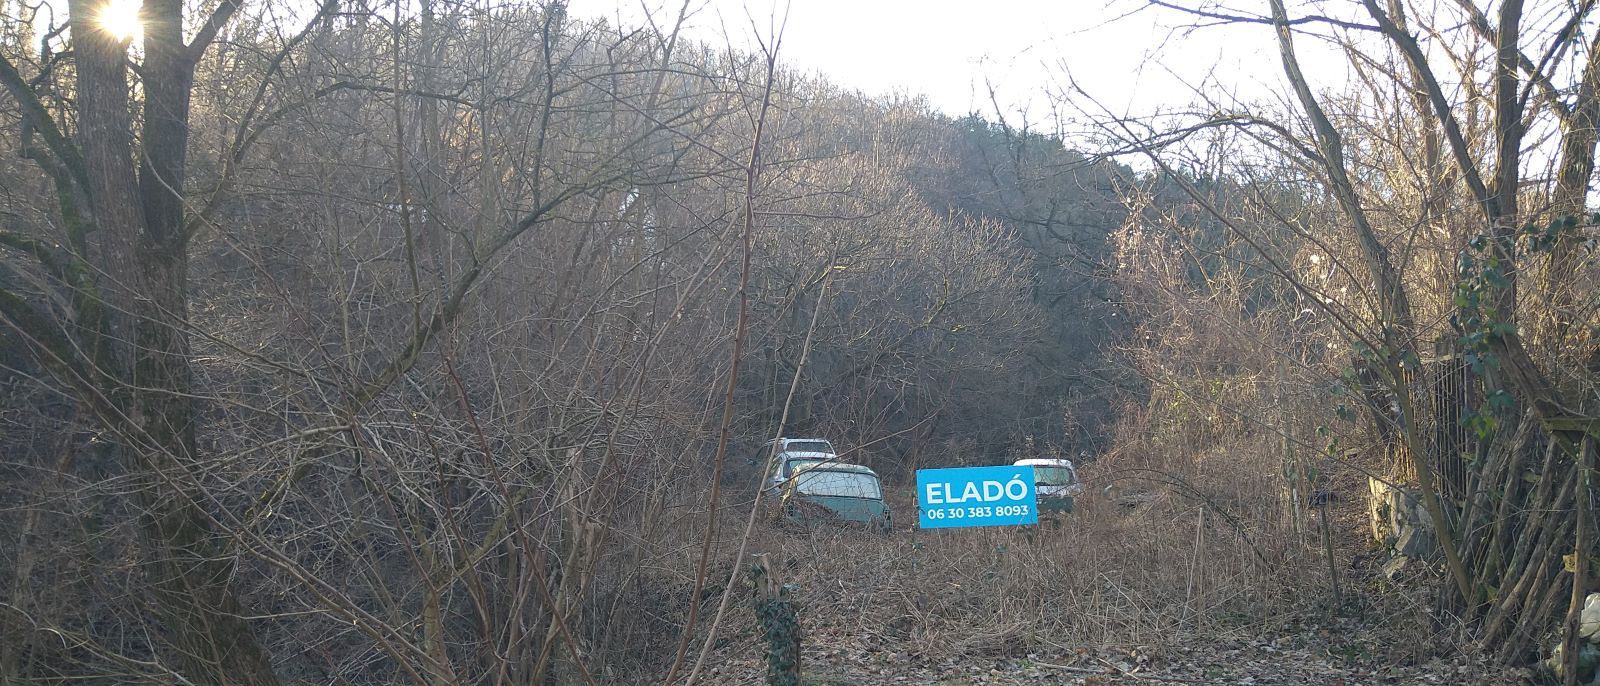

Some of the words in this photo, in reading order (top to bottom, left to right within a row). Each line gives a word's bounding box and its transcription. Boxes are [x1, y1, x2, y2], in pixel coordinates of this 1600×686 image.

[926, 473, 1028, 504] ELADÓ
[927, 509, 945, 520] 06
[947, 508, 965, 519] 30
[967, 506, 992, 518] 383
[995, 505, 1029, 517] 8093
